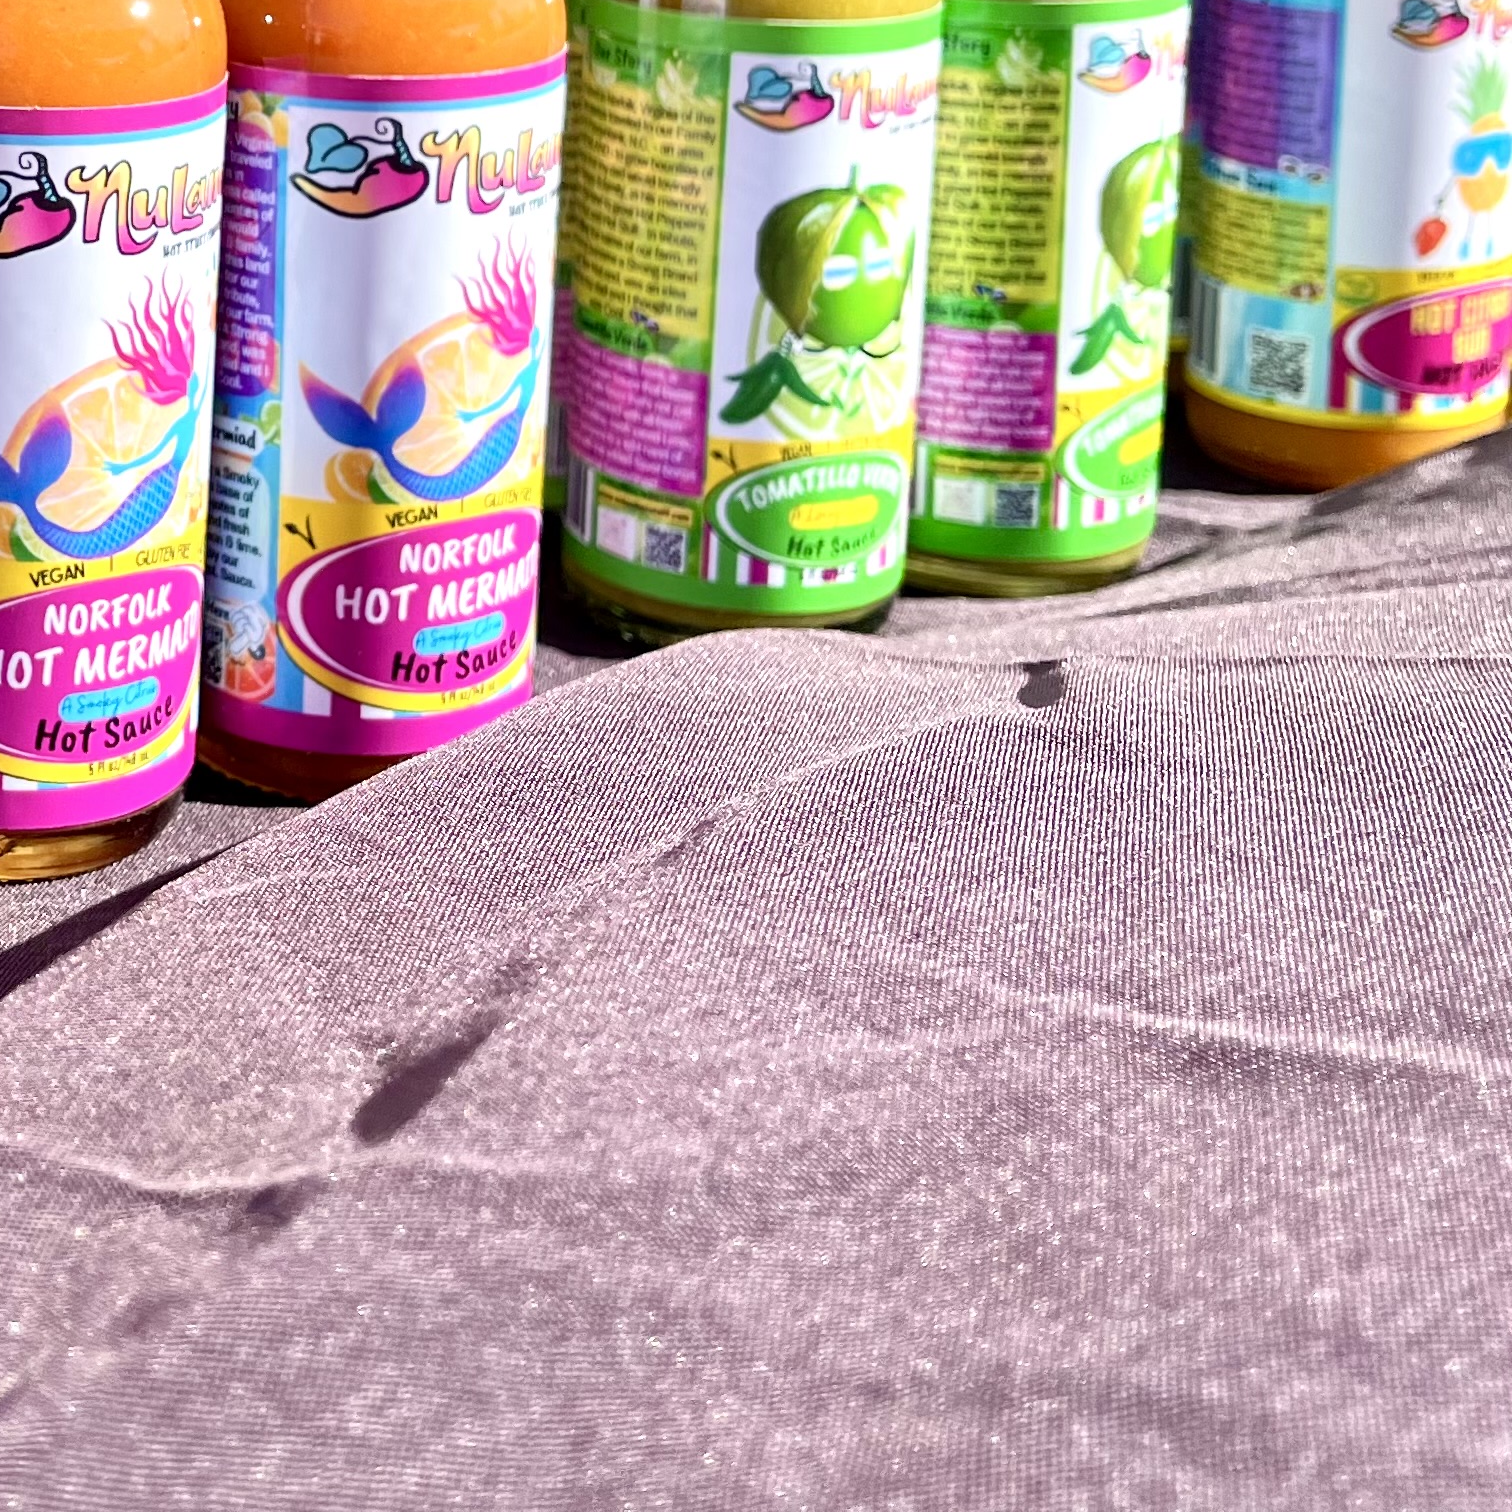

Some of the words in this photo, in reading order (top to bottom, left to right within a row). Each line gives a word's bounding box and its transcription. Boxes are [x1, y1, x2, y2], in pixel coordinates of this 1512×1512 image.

[385, 505, 439, 529] VEGAN
[29, 562, 86, 588] VEGAN
[399, 523, 517, 575] NORFOLK
[43, 581, 173, 637] NORFOLK
[335, 583, 419, 625] HOT
[391, 651, 448, 684] Hot
[455, 630, 516, 680] Sauce
[35, 719, 97, 754] Hot
[103, 694, 173, 749] Sauce
